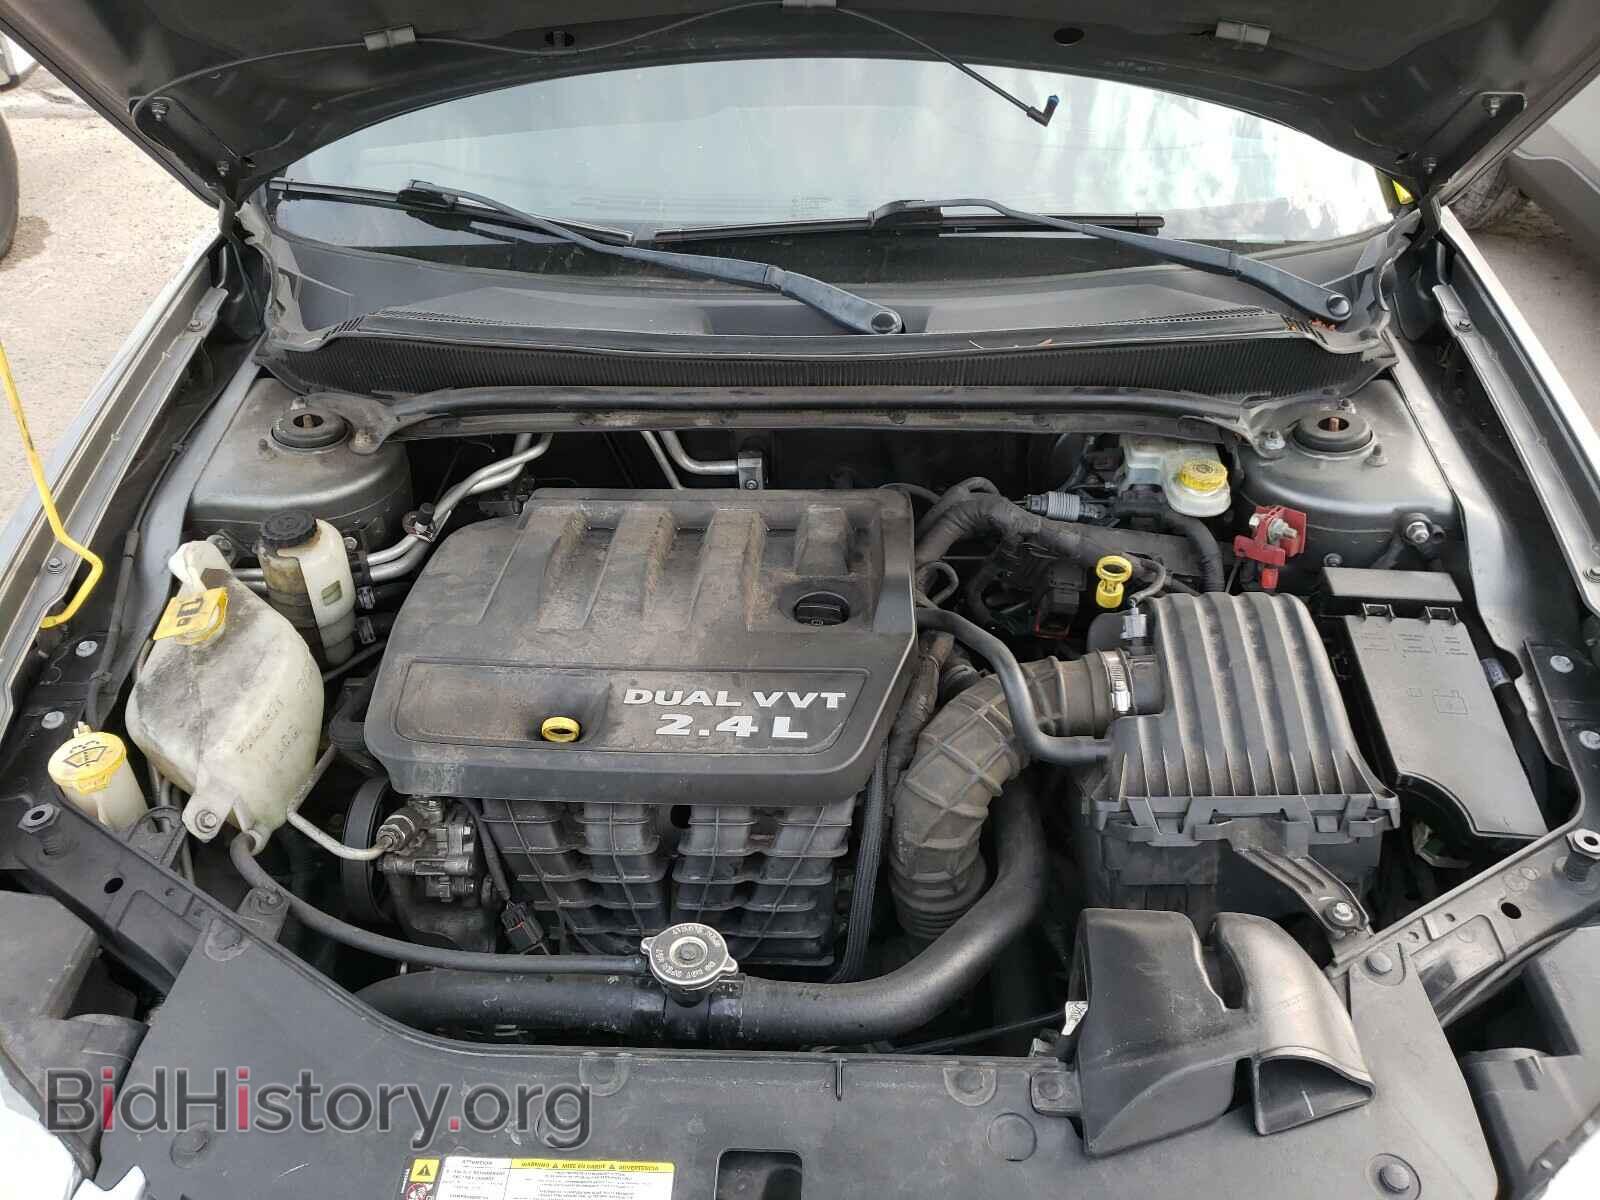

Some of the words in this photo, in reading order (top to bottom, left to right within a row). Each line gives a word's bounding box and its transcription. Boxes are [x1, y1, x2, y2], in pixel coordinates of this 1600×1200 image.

[623, 687, 743, 707] DUAL
[751, 690, 848, 709] VVT
[655, 713, 759, 738] 2.4
